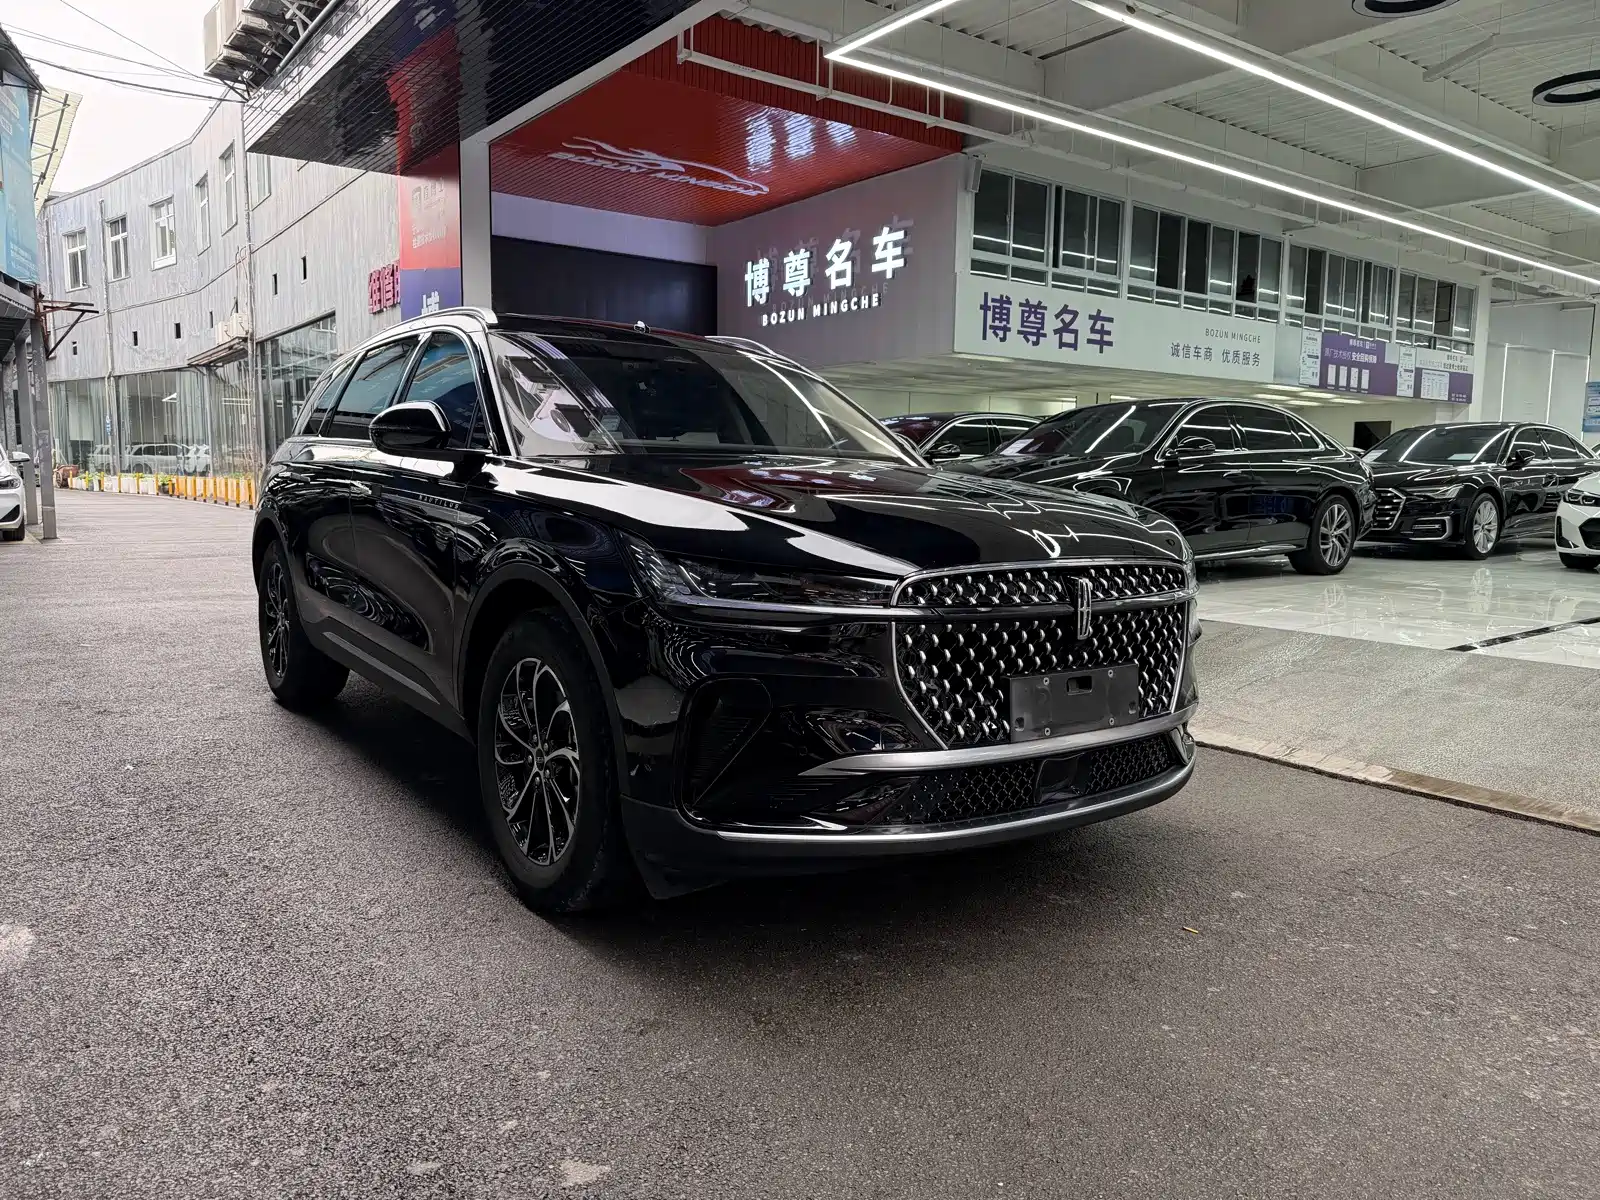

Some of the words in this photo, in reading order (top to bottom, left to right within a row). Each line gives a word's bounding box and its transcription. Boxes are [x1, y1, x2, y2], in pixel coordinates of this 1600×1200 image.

[744, 226, 905, 307] 博尊名车
[762, 307, 805, 326] BOZUN
[812, 293, 879, 318] MINGCHE
[979, 291, 1115, 354] 博尊名车
[1205, 328, 1229, 339] BOZUN
[1231, 331, 1261, 344] MINGCHE
[1170, 342, 1213, 362] 诚信车商
[1221, 348, 1261, 367] 优质服务
[418, 494, 460, 510] NAUTILUS
